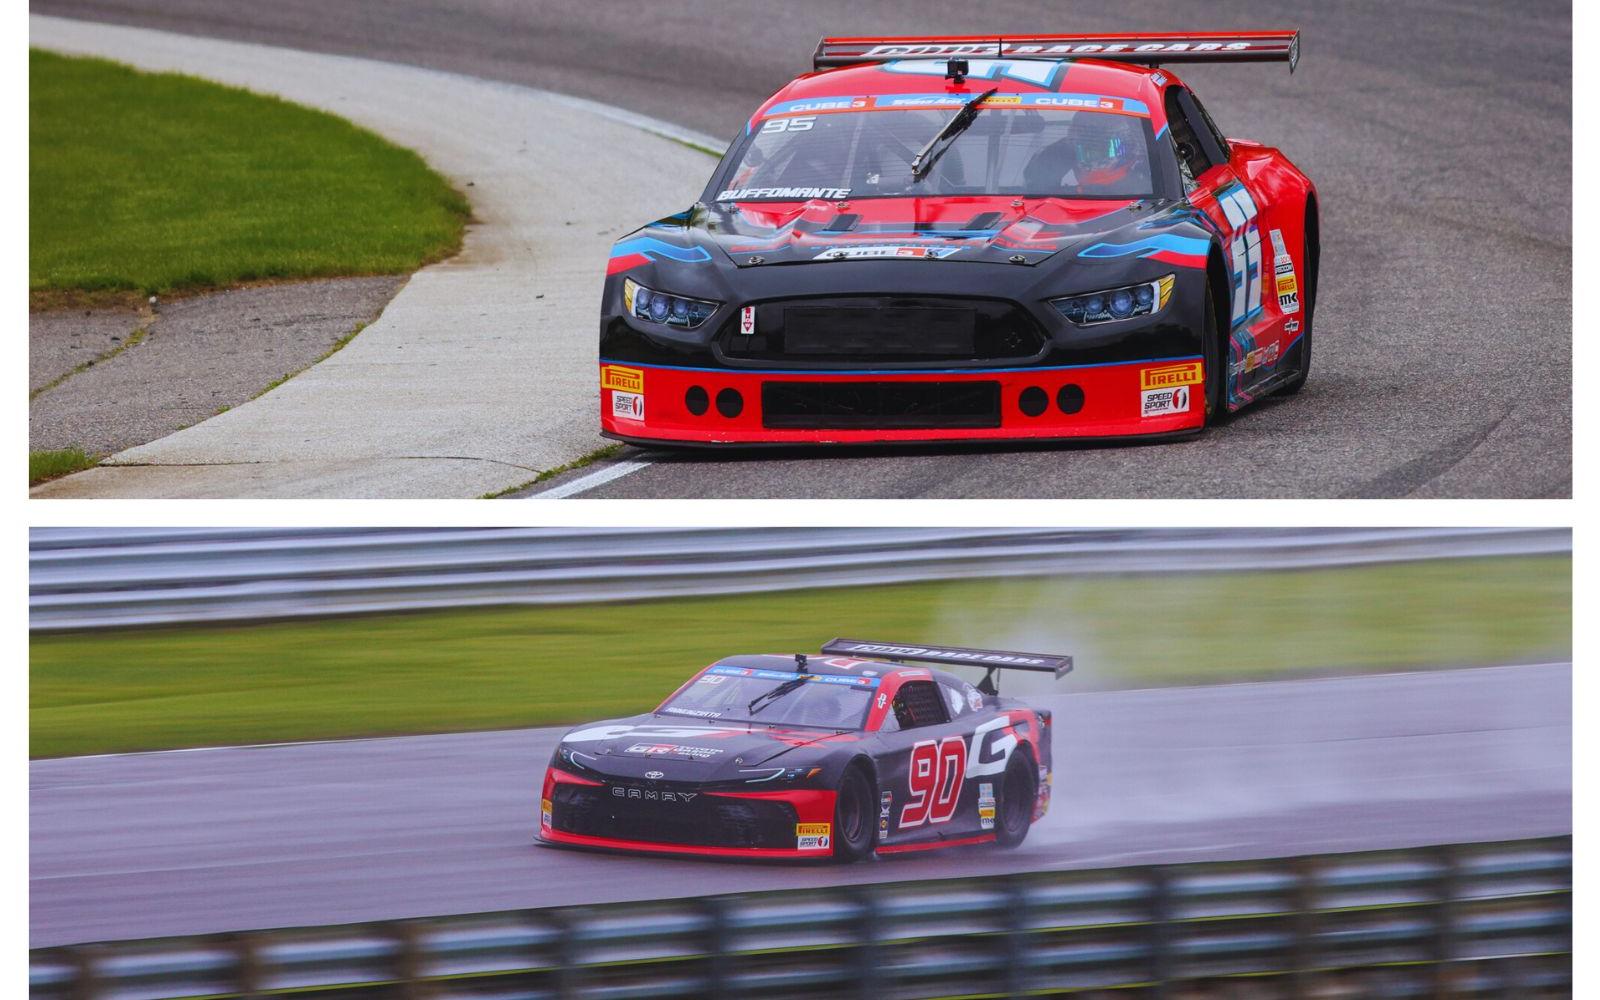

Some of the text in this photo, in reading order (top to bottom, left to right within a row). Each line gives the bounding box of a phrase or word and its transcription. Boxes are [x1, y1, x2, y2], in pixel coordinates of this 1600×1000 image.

[1012, 44, 1128, 53] RACE
[1134, 43, 1251, 51] CARS
[762, 116, 817, 134] 95
[716, 187, 851, 200] BUFFOMANTE
[605, 368, 640, 390] PIRELLI
[1145, 365, 1197, 386] PIRELLI
[616, 395, 632, 404] SPEED
[1147, 392, 1172, 402] SPEED
[615, 403, 632, 411] SPORT
[1144, 400, 1171, 410] SPORT
[698, 675, 726, 685] 90
[898, 735, 967, 828] 90
[612, 786, 698, 802] CAMRY
[798, 825, 828, 834] PIRELLI
